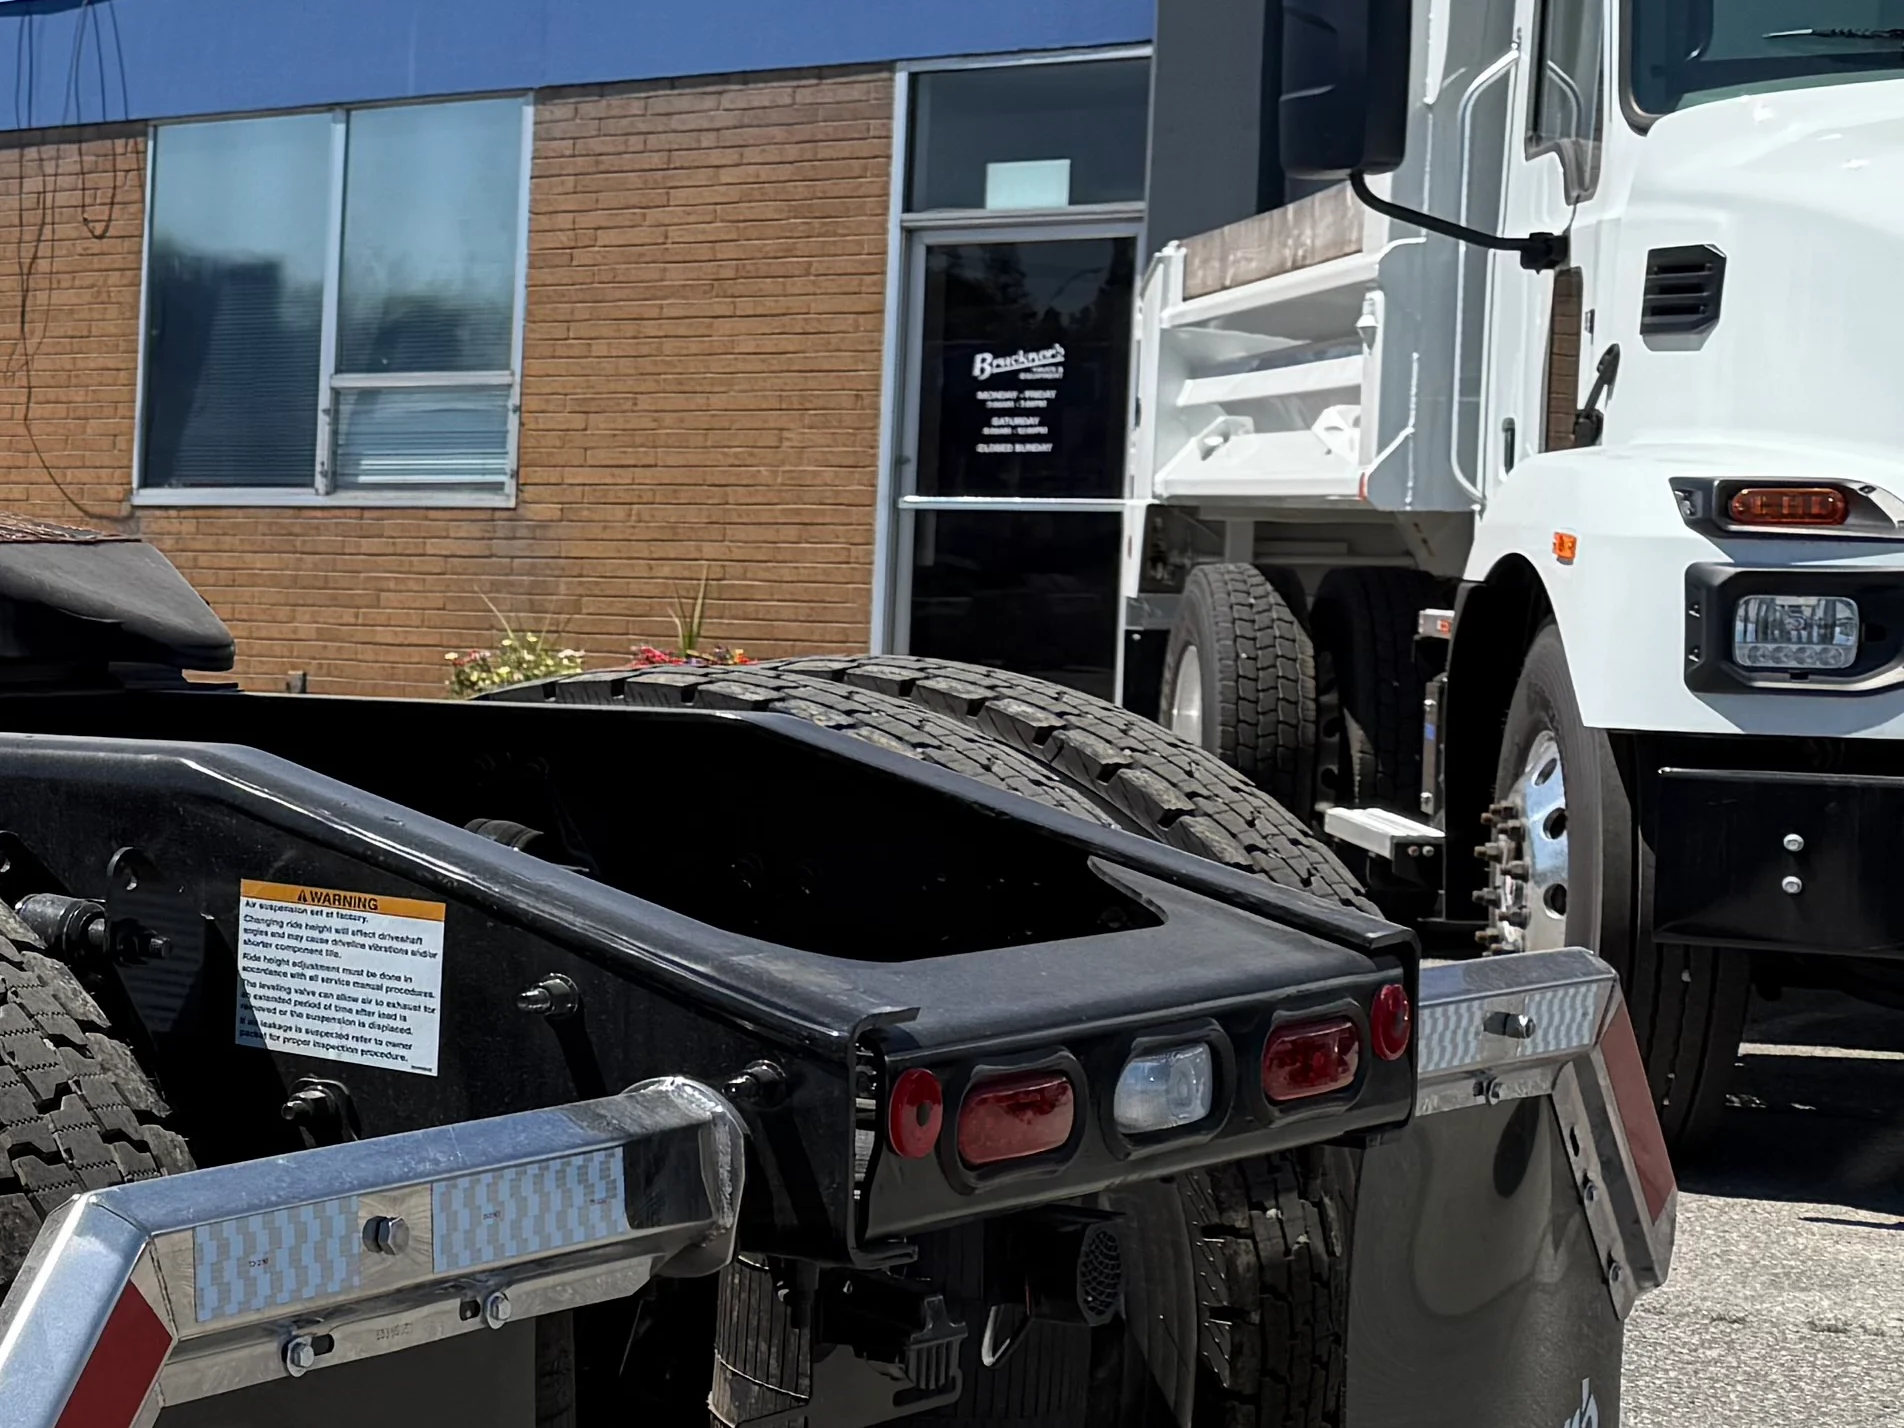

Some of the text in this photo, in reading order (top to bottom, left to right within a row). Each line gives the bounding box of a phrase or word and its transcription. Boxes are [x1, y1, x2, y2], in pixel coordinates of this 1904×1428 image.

[972, 343, 1066, 381] Bruckner's
[991, 417, 1040, 426] SATURDAY
[245, 900, 256, 909] Air
[259, 903, 308, 915] suspension
[310, 909, 323, 917] set
[336, 911, 368, 924] factory.
[310, 890, 379, 911] WARNING
[243, 914, 423, 945] Changing ride height will affect driveshaft
[243, 927, 268, 937] angles
[270, 931, 285, 939] and
[287, 933, 304, 943] may
[305, 935, 329, 945] cause
[331, 938, 366, 950] driveline
[368, 943, 409, 955] vibrations
[274, 943, 323, 956] component
[325, 949, 342, 958] life.
[242, 952, 261, 962] Ride
[263, 955, 290, 967] height
[292, 960, 340, 974] adjustment
[342, 967, 364, 976] must
[366, 969, 378, 978] be
[379, 972, 401, 982] done
[242, 966, 436, 998] accordance with all service manual procedures.
[243, 979, 436, 1014] The leveling valve can allow air to exhaust for
[253, 993, 292, 1005] extended
[293, 999, 321, 1010] period
[323, 1003, 332, 1011] of
[334, 1004, 353, 1014] time
[355, 1007, 376, 1017] after
[378, 1010, 397, 1021] load
[260, 1020, 293, 1033] leakage
[305, 1028, 349, 1040] suspected
[351, 1034, 373, 1044] refer
[374, 1037, 383, 1046] to
[385, 1040, 412, 1050] owner
[290, 1009, 304, 1019] the
[305, 1013, 356, 1026] suspension
[368, 1021, 413, 1035] displaced.
[268, 1032, 281, 1041] for
[282, 1036, 311, 1046] proper
[313, 1039, 359, 1054] inspection
[360, 1048, 408, 1062] procedure.
